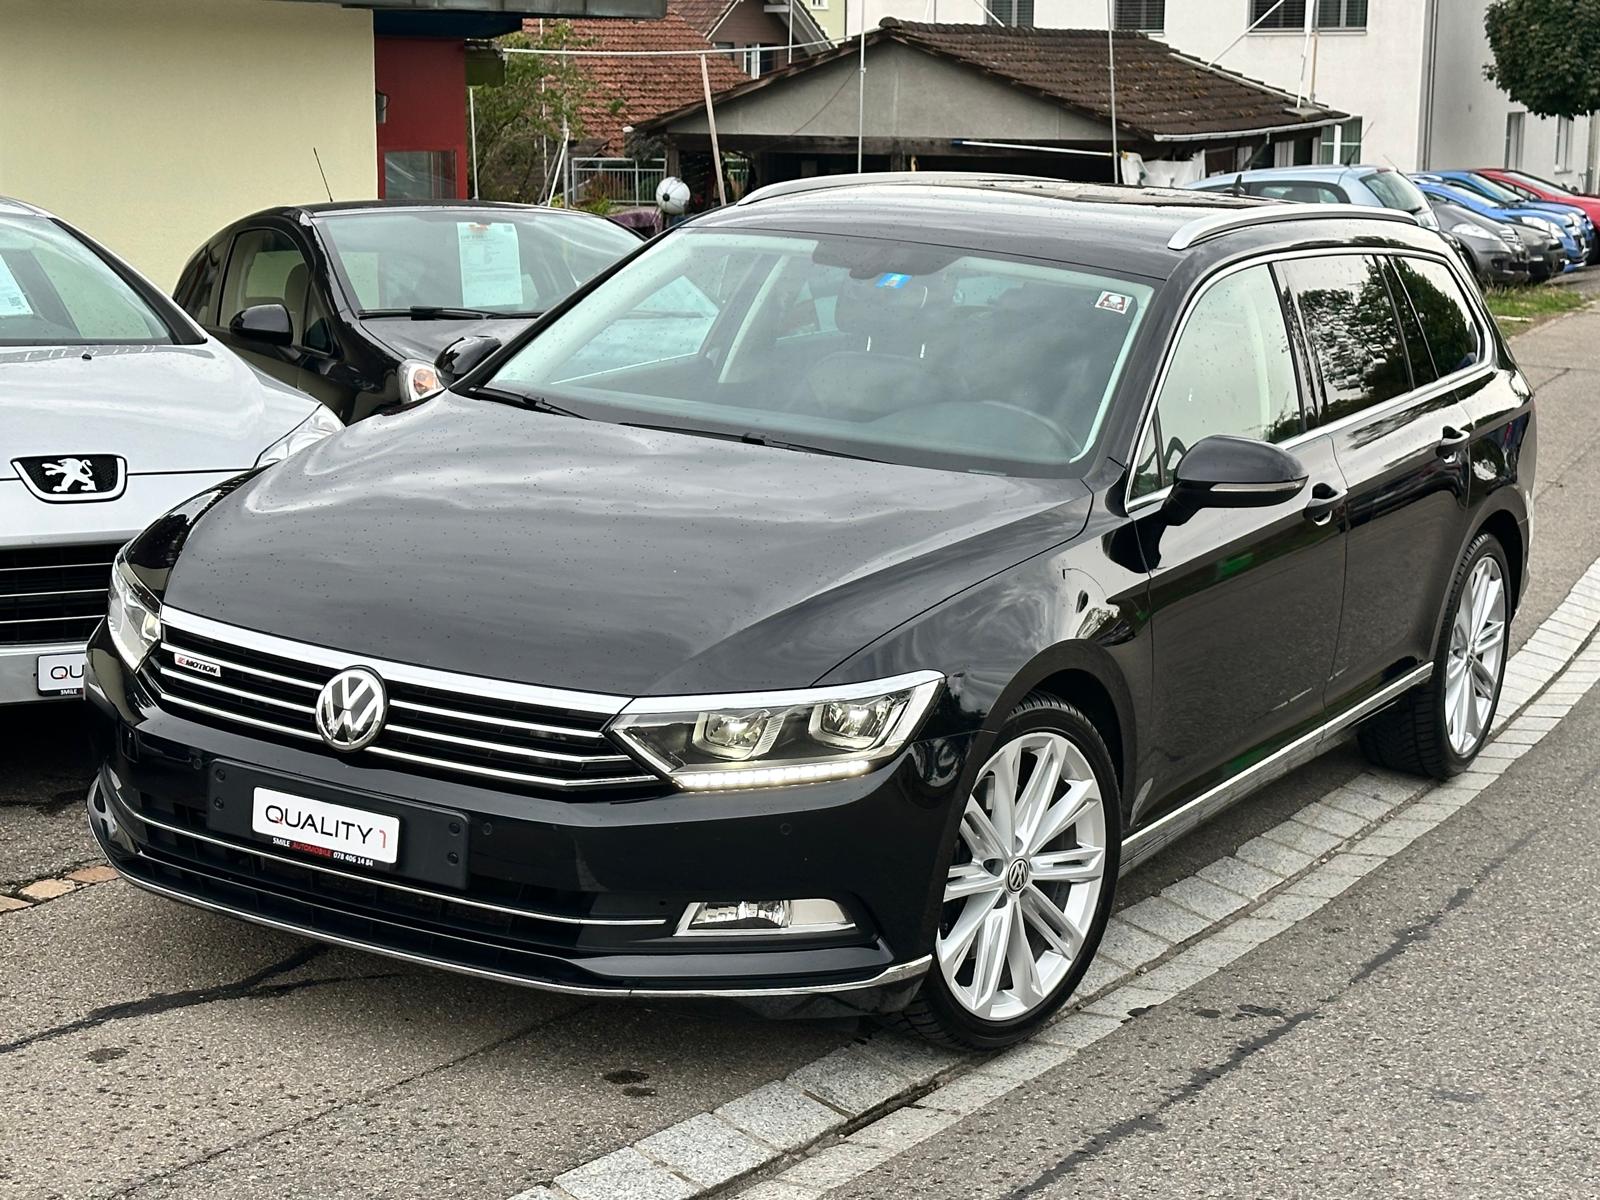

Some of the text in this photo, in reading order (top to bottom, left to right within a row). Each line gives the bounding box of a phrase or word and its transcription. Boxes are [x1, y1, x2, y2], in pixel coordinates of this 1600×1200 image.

[265, 804, 374, 845] QUALITY
[272, 836, 291, 848] SMILE
[292, 840, 332, 858] AUTOMOBILE
[333, 851, 345, 861] 078
[357, 857, 365, 866] 14
[365, 859, 374, 867] 84
